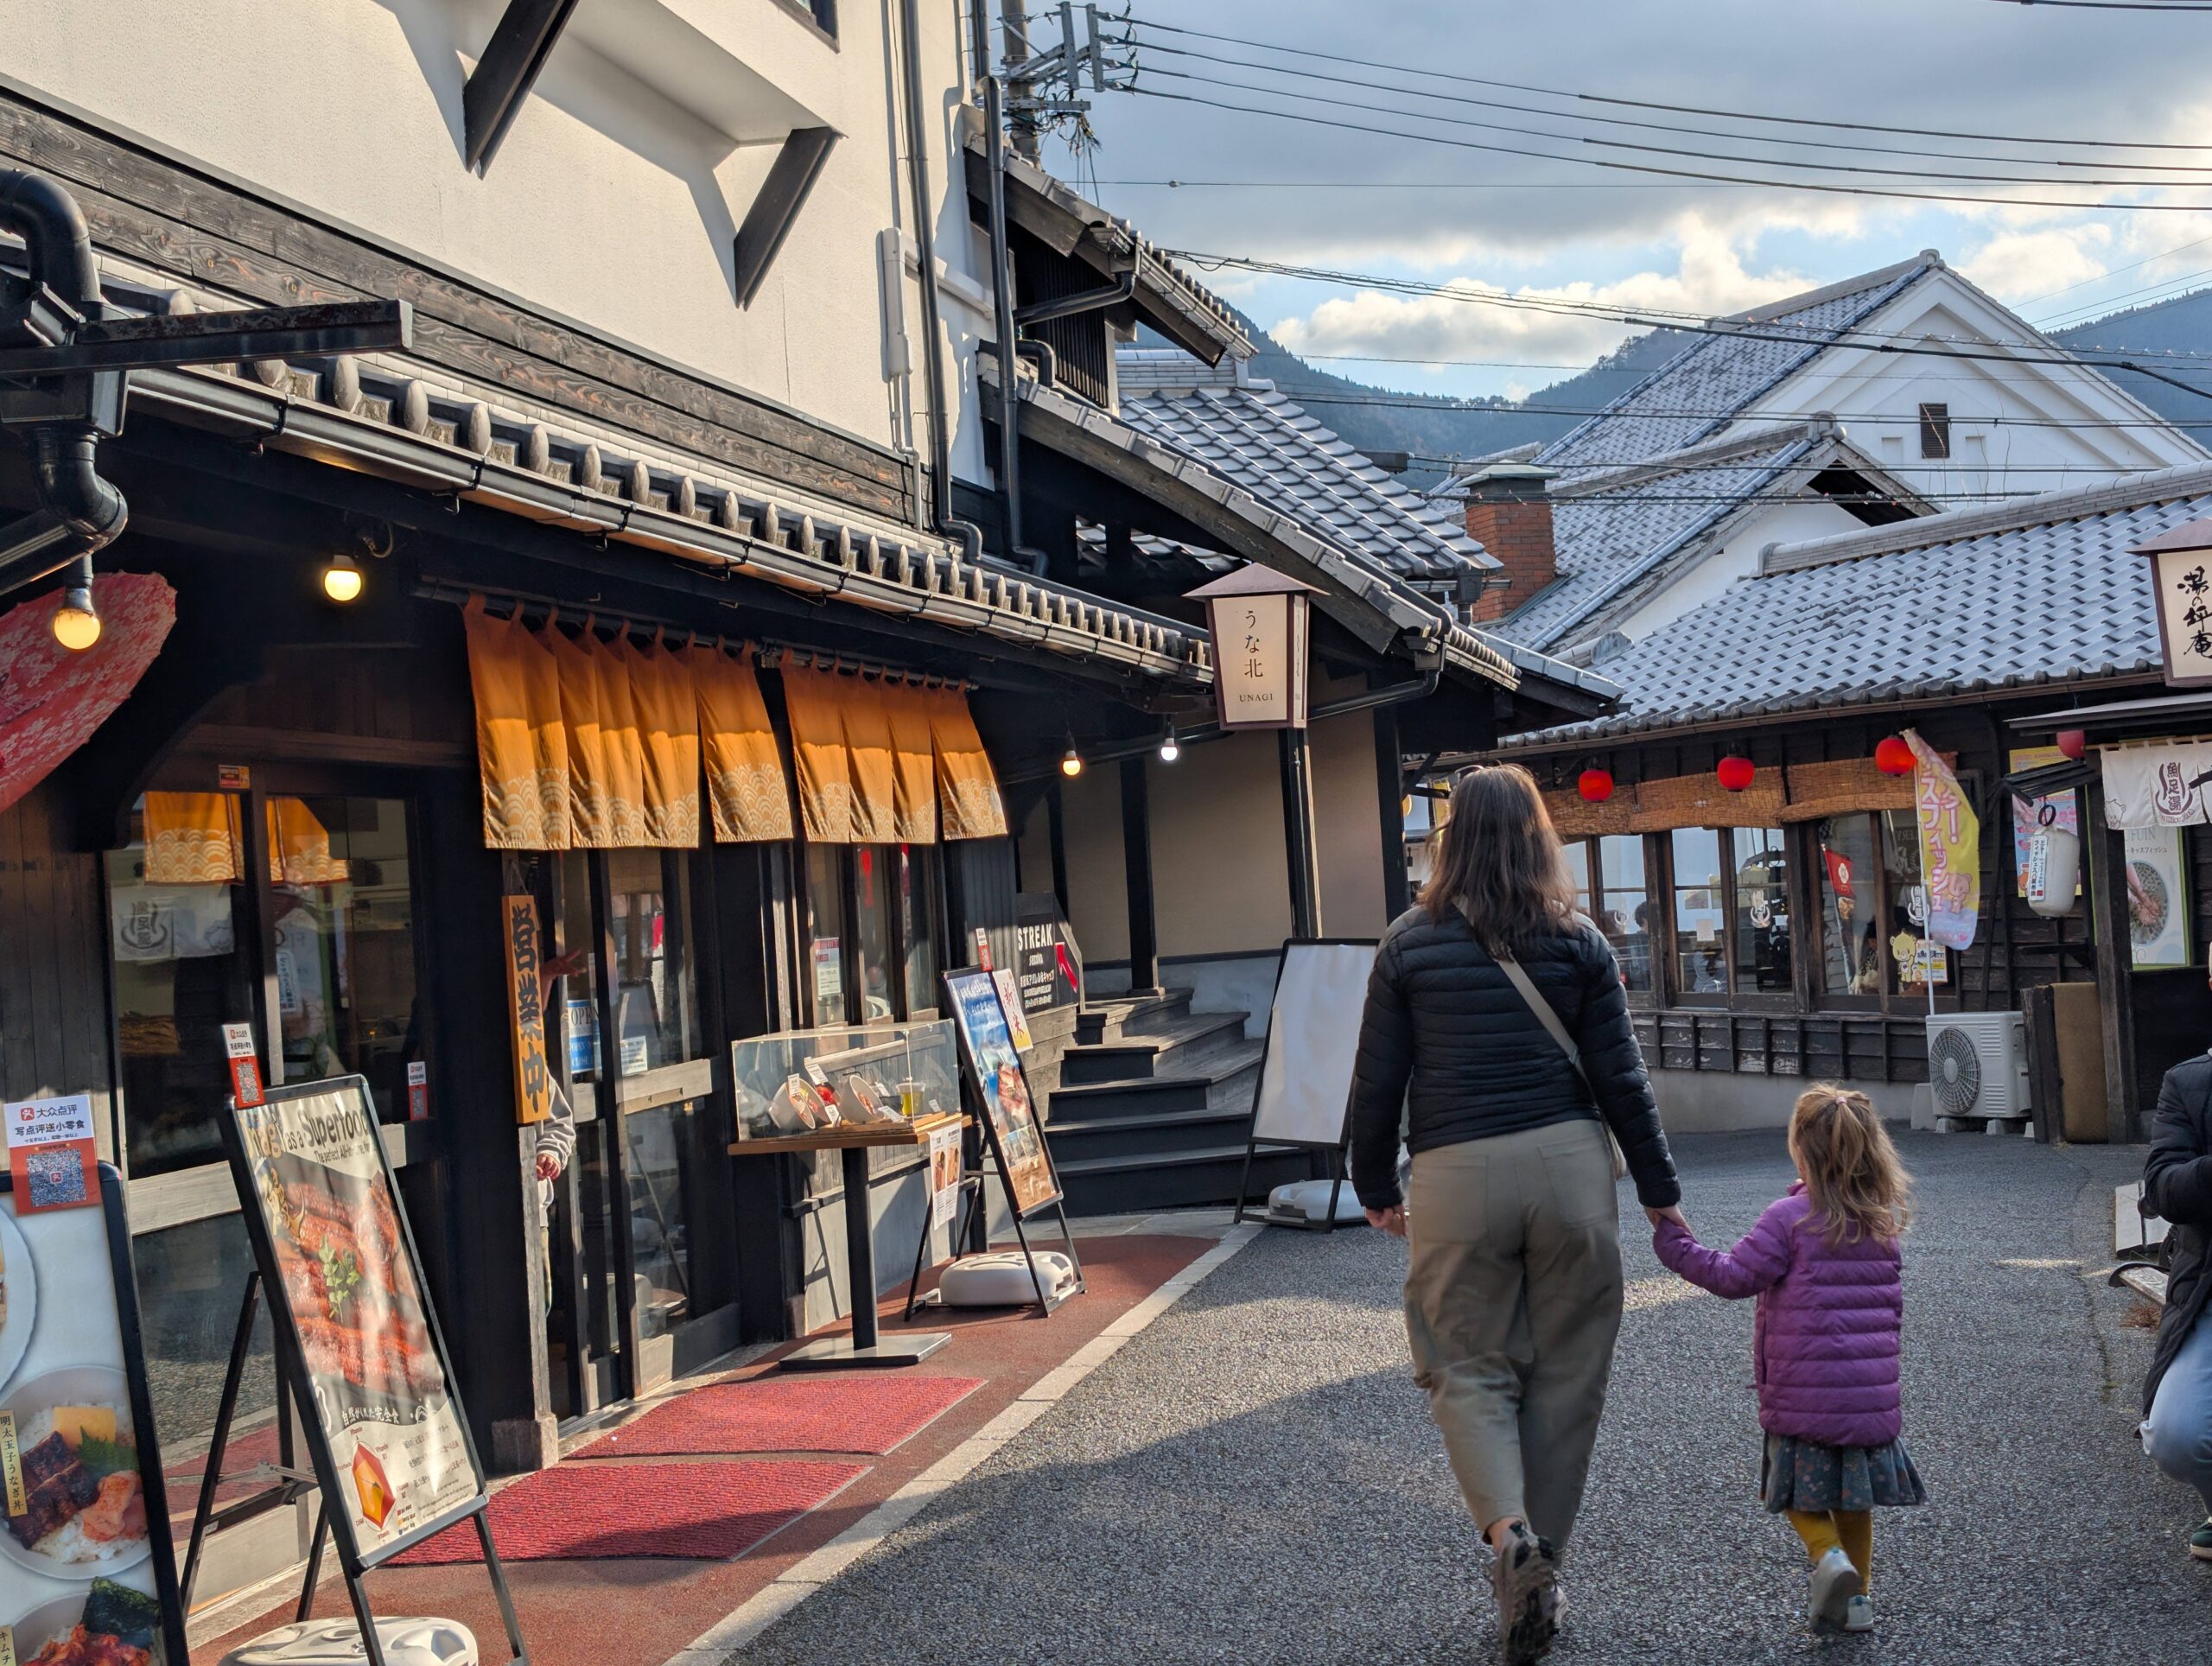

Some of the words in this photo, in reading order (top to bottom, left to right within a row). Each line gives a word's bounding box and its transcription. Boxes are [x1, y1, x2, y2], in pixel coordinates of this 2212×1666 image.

[1244, 610, 1263, 678] うな北
[1239, 692, 1273, 703] UNAGI
[2167, 762, 2182, 811] 魚足湯
[1018, 923, 1053, 951] STREAK
[512, 902, 544, 1114] 営業中
[36, 1104, 78, 1119] 大众点评
[15, 1120, 85, 1136] 写点评送小零食
[287, 1132, 298, 1151] as
[297, 1130, 305, 1148] a
[0, 1415, 23, 1510] 明太玉子うなぎ丼
